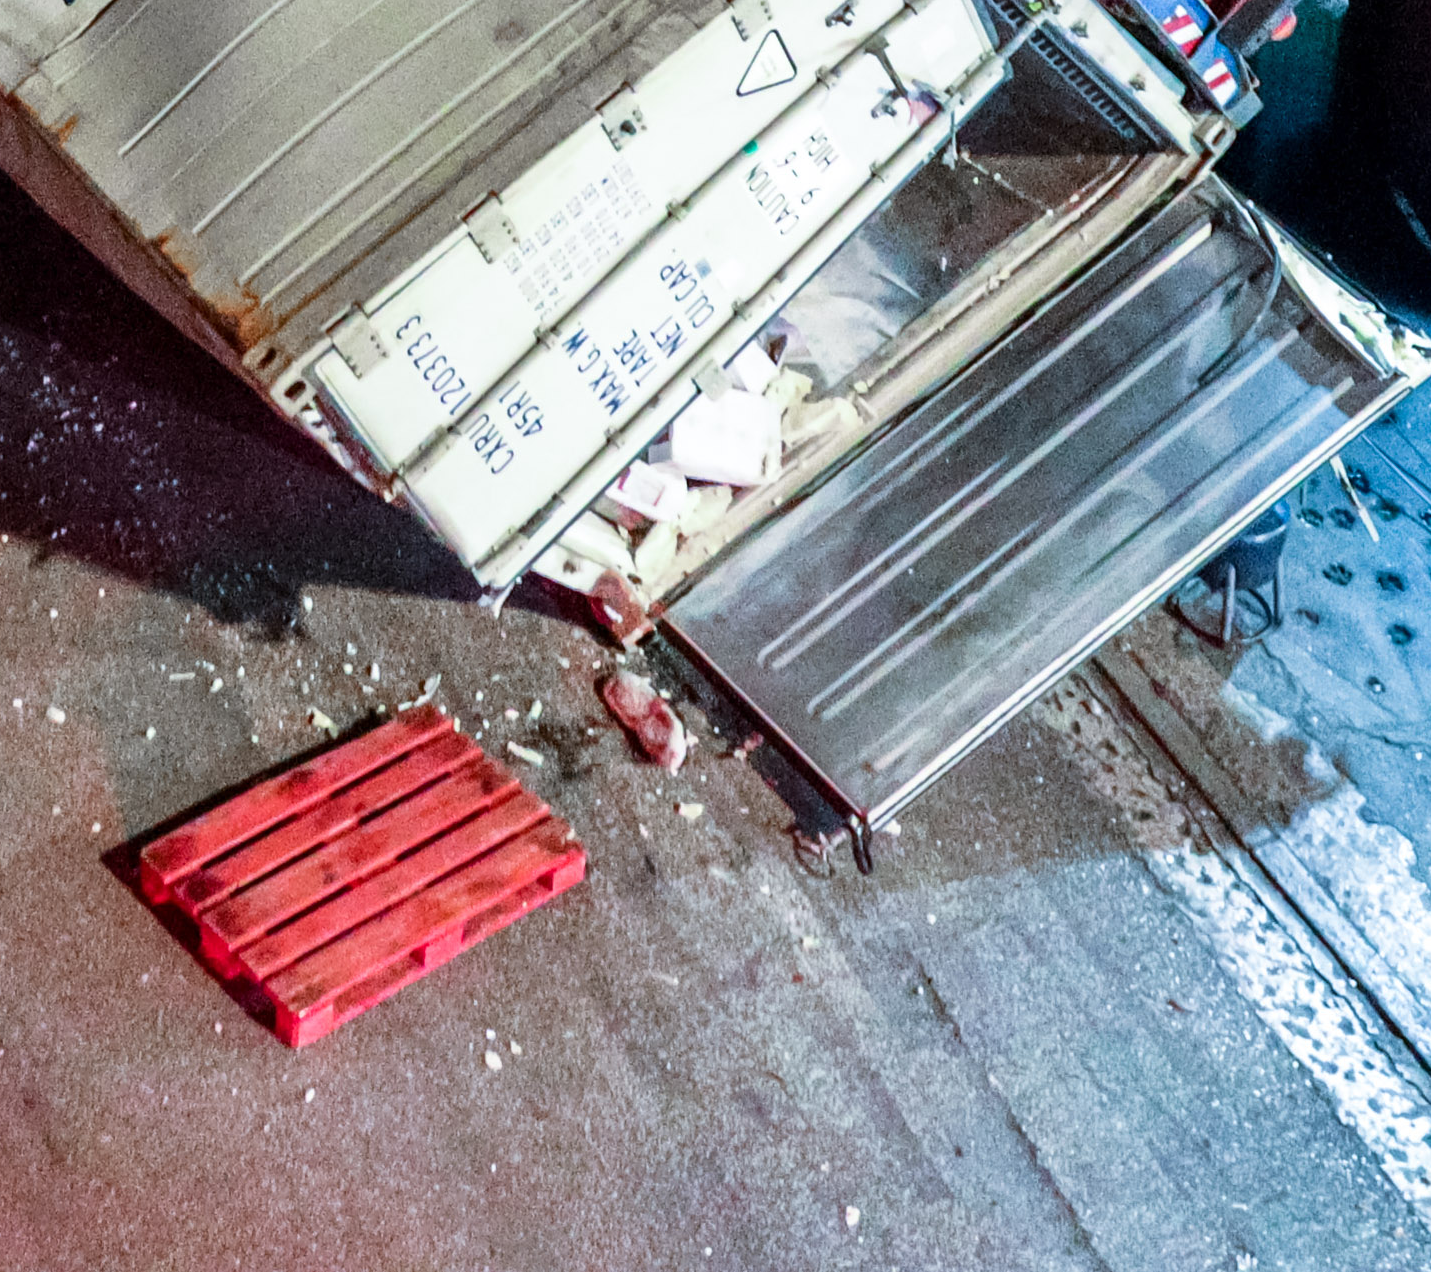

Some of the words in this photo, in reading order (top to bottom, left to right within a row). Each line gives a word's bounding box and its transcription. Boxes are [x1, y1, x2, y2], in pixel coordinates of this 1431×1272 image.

[802, 127, 839, 174] HIGH
[743, 161, 799, 235] CAUTION
[613, 328, 658, 387] TARE
[650, 315, 688, 359] NET
[407, 332, 472, 415] 120373
[499, 380, 544, 437] 45R1
[464, 413, 515, 474] CXRU
